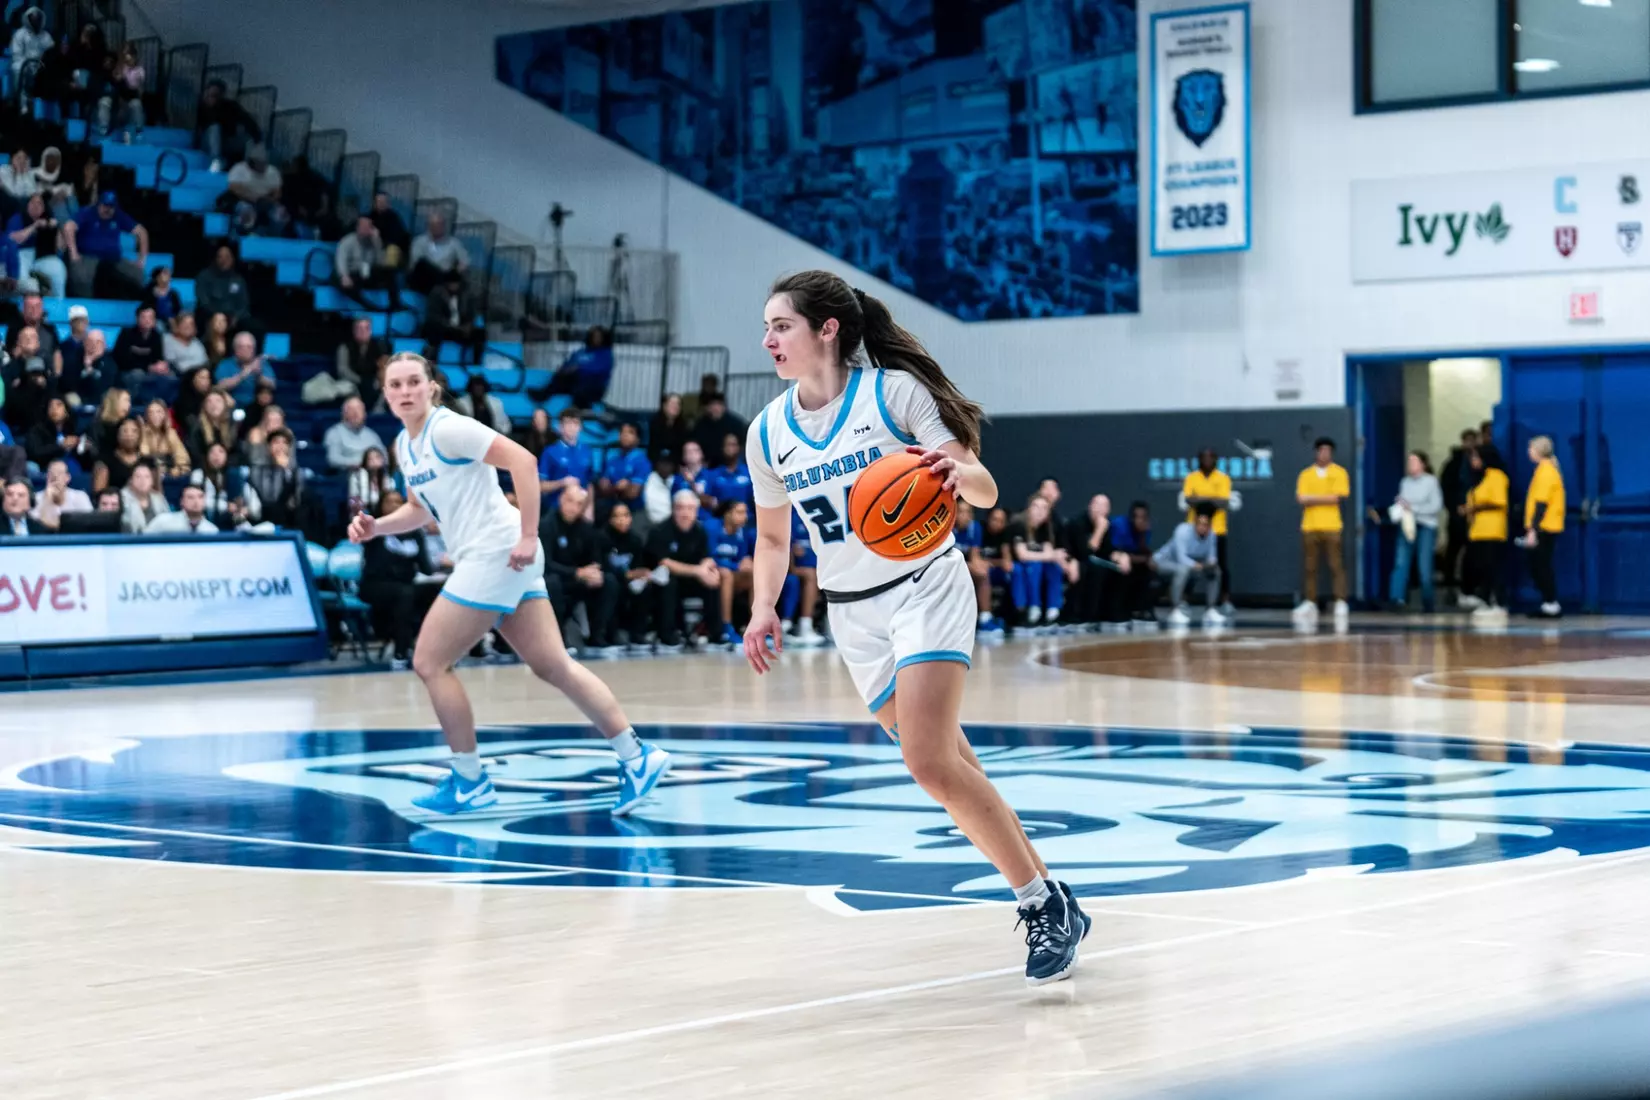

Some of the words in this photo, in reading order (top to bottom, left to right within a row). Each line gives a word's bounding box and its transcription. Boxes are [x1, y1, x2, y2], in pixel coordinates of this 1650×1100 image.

[1170, 202, 1228, 231] 2023
[1397, 204, 1468, 257] Ivy
[798, 484, 854, 545] 2
[900, 502, 950, 549] ELITE
[118, 576, 293, 602] JAGONEPT.COM
